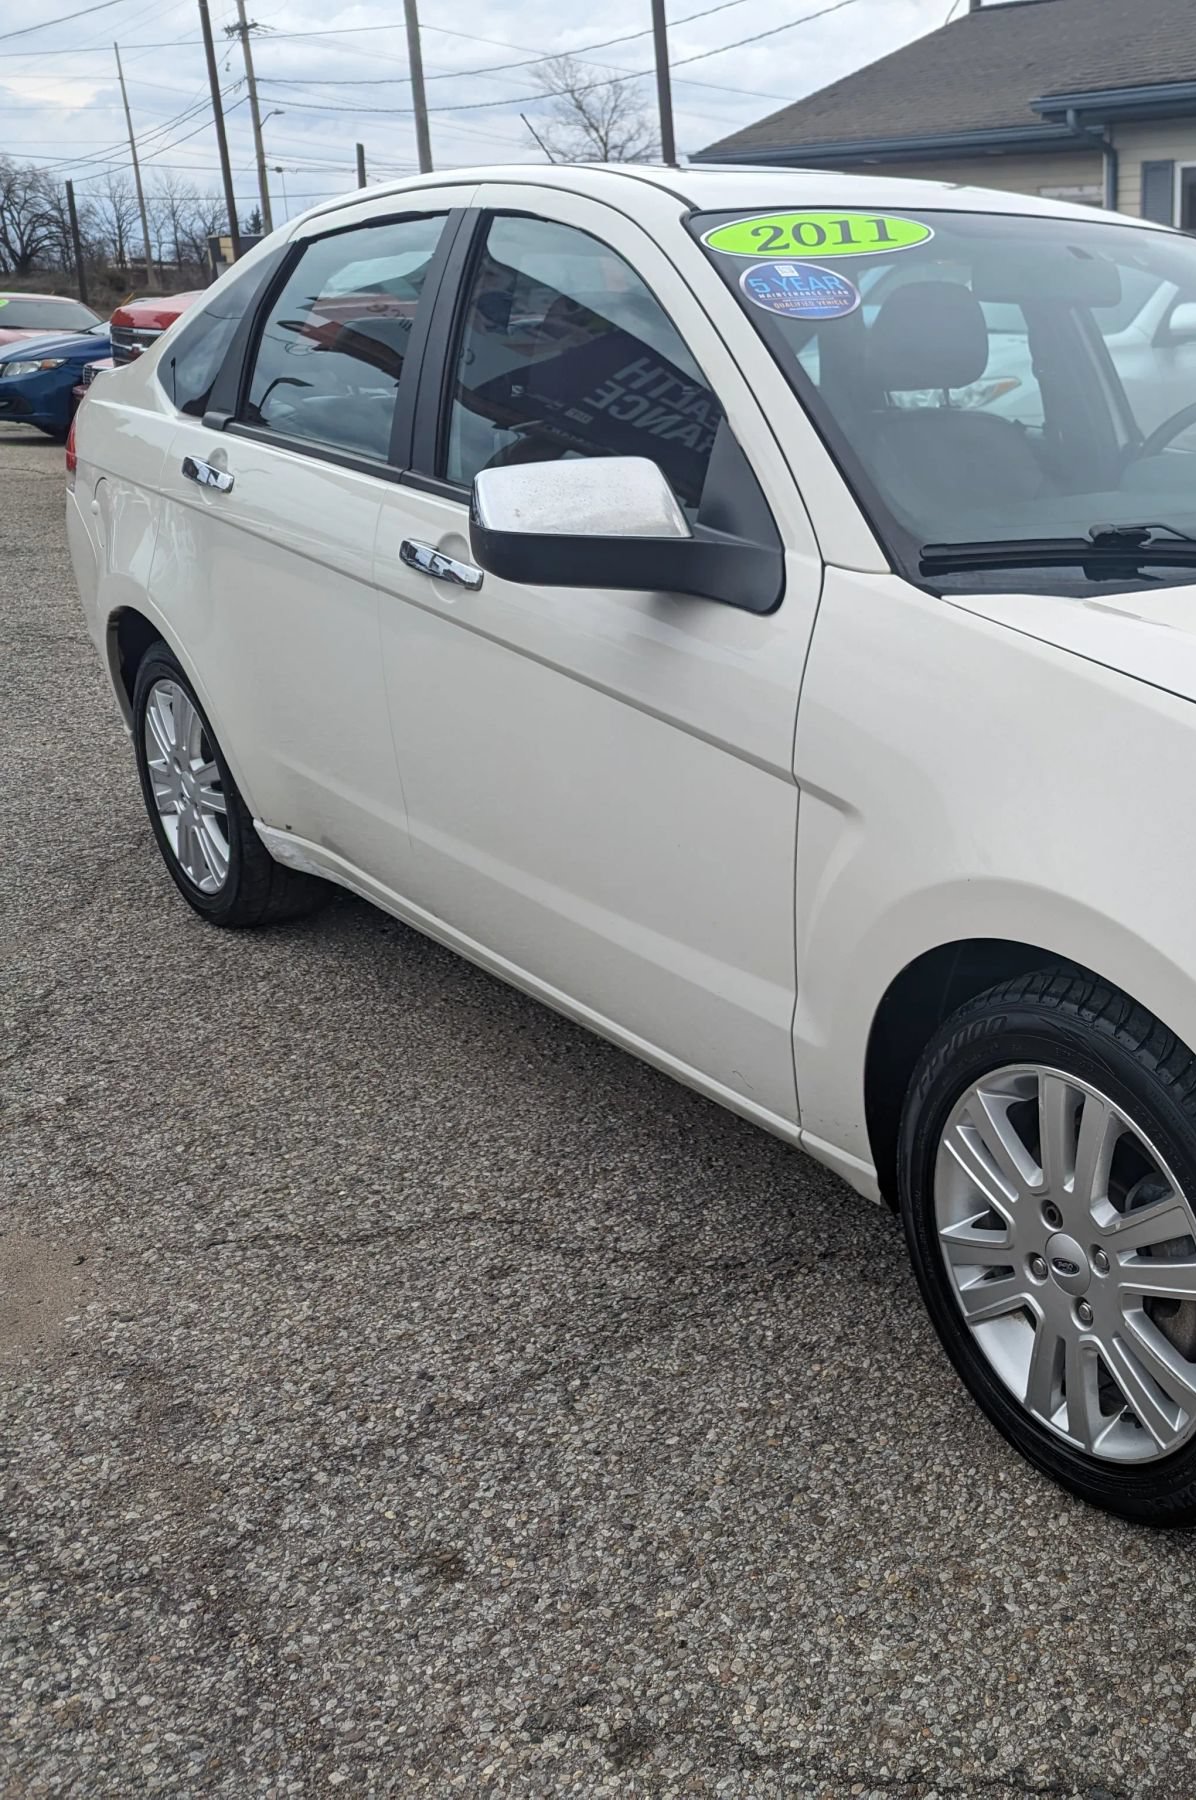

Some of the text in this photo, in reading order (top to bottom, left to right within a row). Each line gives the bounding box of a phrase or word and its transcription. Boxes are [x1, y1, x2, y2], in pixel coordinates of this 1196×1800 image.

[751, 218, 898, 252] 2011
[748, 276, 845, 293] 5 YEAR
[758, 291, 822, 299] MAINTENANCE
